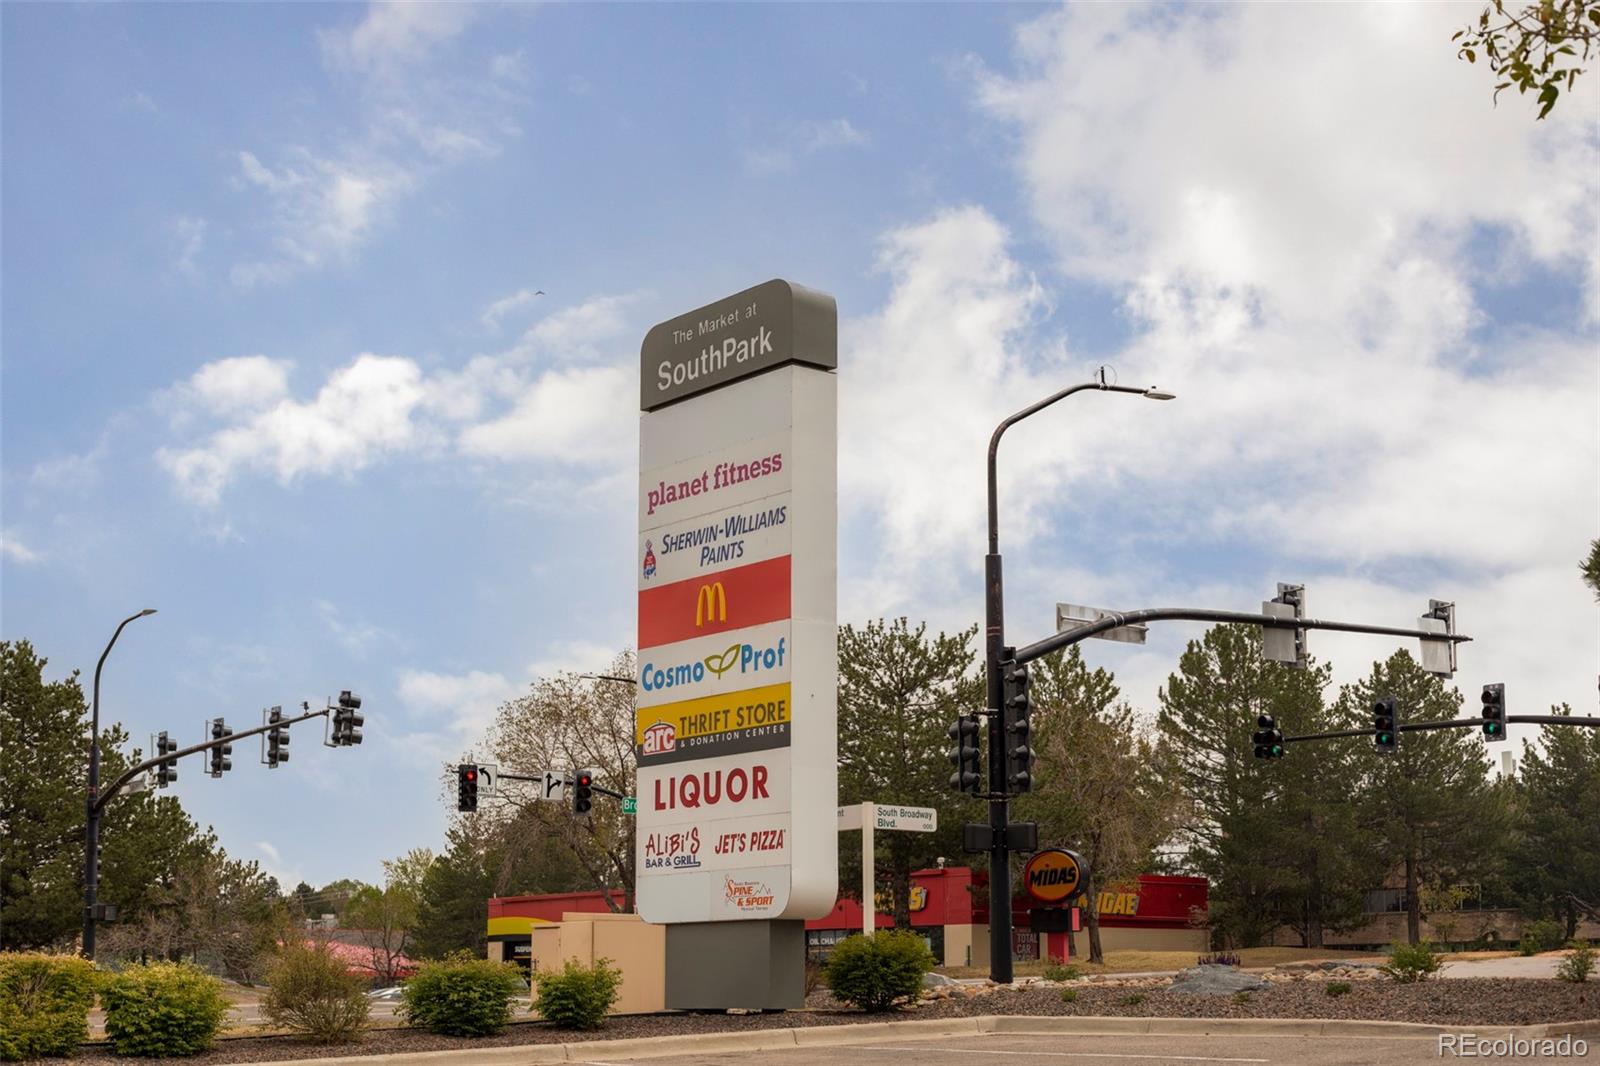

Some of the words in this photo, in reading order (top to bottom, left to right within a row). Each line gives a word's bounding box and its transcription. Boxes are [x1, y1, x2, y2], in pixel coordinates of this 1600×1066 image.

[673, 327, 693, 344] The
[698, 309, 739, 336] Market
[745, 302, 757, 318] at
[657, 326, 773, 391] SouthPark
[647, 470, 708, 515] planet
[713, 453, 782, 489] fitness
[661, 506, 786, 555] SHERWIN-WILLIAMS
[700, 540, 744, 567] PAINTS
[642, 661, 704, 691] Cosmo
[741, 637, 785, 673] Prof
[679, 709, 730, 736] THRIFT
[736, 700, 785, 727] STORE
[644, 727, 674, 752] arc
[680, 740, 685, 748] &
[690, 731, 740, 746] DONATION
[745, 724, 785, 738] CENTER
[654, 765, 769, 811] LIQUOR
[877, 806, 898, 817] South
[900, 808, 933, 820] Broadway
[877, 818, 897, 828] Blvd.
[714, 833, 746, 855] JET'S
[750, 829, 784, 852] PIZZA
[645, 857, 663, 868] BAR
[664, 857, 672, 867] &
[673, 854, 701, 867] GRILL
[726, 879, 753, 898] SPINE
[1029, 865, 1076, 887] MIDAS
[737, 897, 744, 906] &
[745, 896, 774, 906] SPORT
